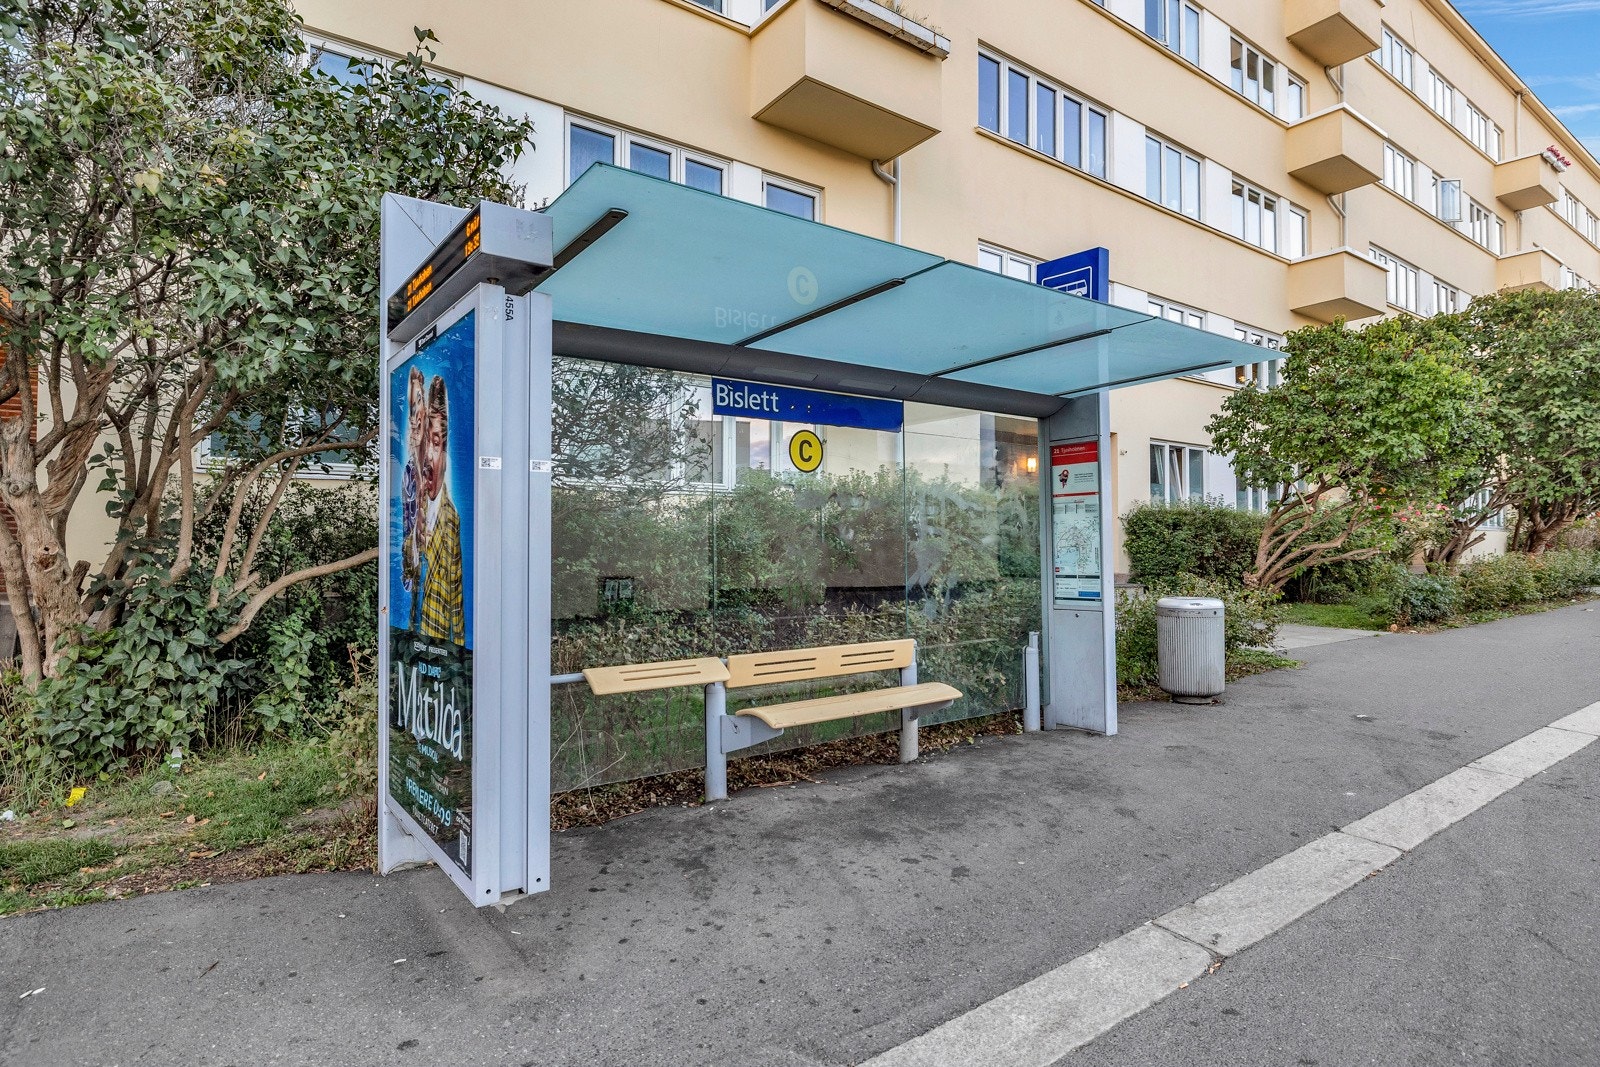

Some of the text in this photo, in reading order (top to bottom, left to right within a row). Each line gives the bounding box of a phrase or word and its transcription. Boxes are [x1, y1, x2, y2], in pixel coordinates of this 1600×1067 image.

[505, 296, 514, 321] 455A
[716, 383, 779, 412] Bislett
[799, 439, 813, 463] C
[397, 660, 463, 762] Matilda
